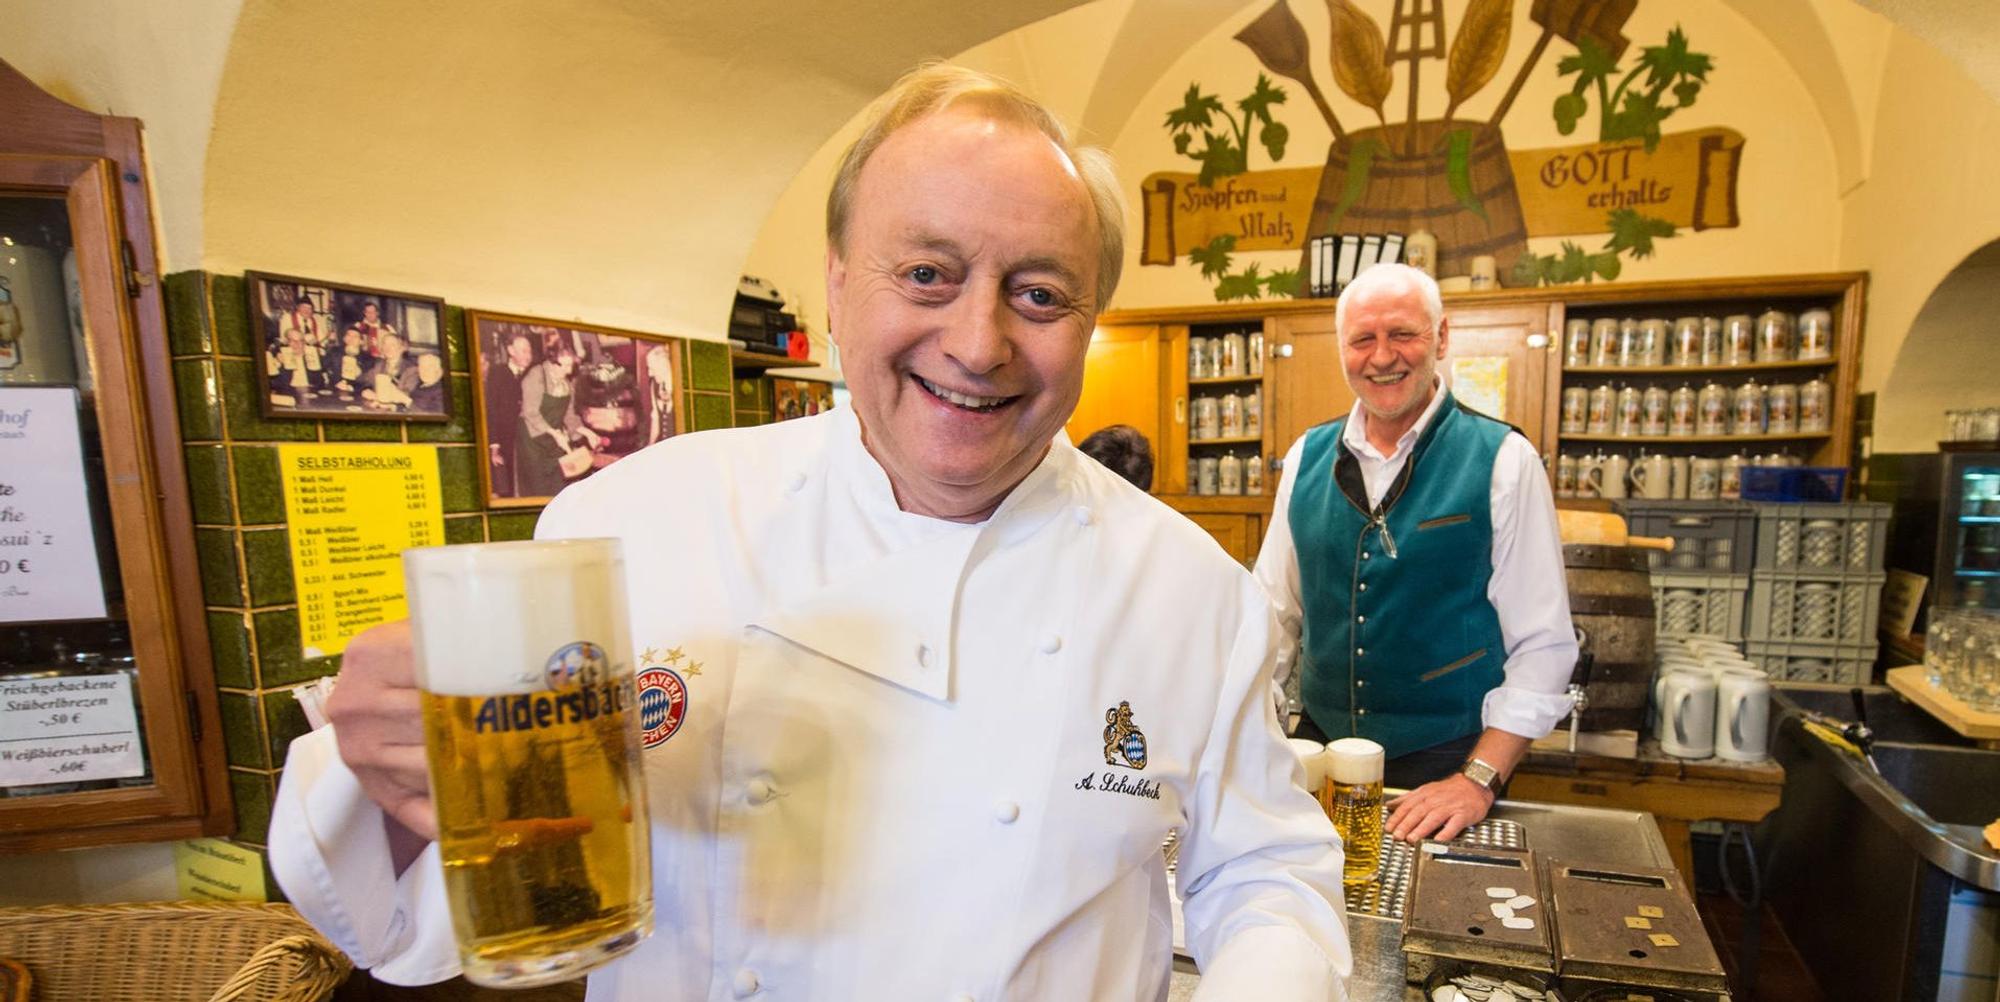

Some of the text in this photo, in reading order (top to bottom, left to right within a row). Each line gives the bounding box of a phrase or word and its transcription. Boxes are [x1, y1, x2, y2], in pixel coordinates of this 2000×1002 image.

[1540, 145, 1644, 188] GOTT
[1180, 179, 1257, 216] Hopfen
[1239, 211, 1294, 244] Malz
[297, 456, 412, 469] SELBSTABHOLUNG
[17, 559, 31, 573] €
[639, 673, 682, 704] BAYERN
[641, 715, 678, 744] CHEN
[1074, 771, 1160, 800] A. Schuhbeck
